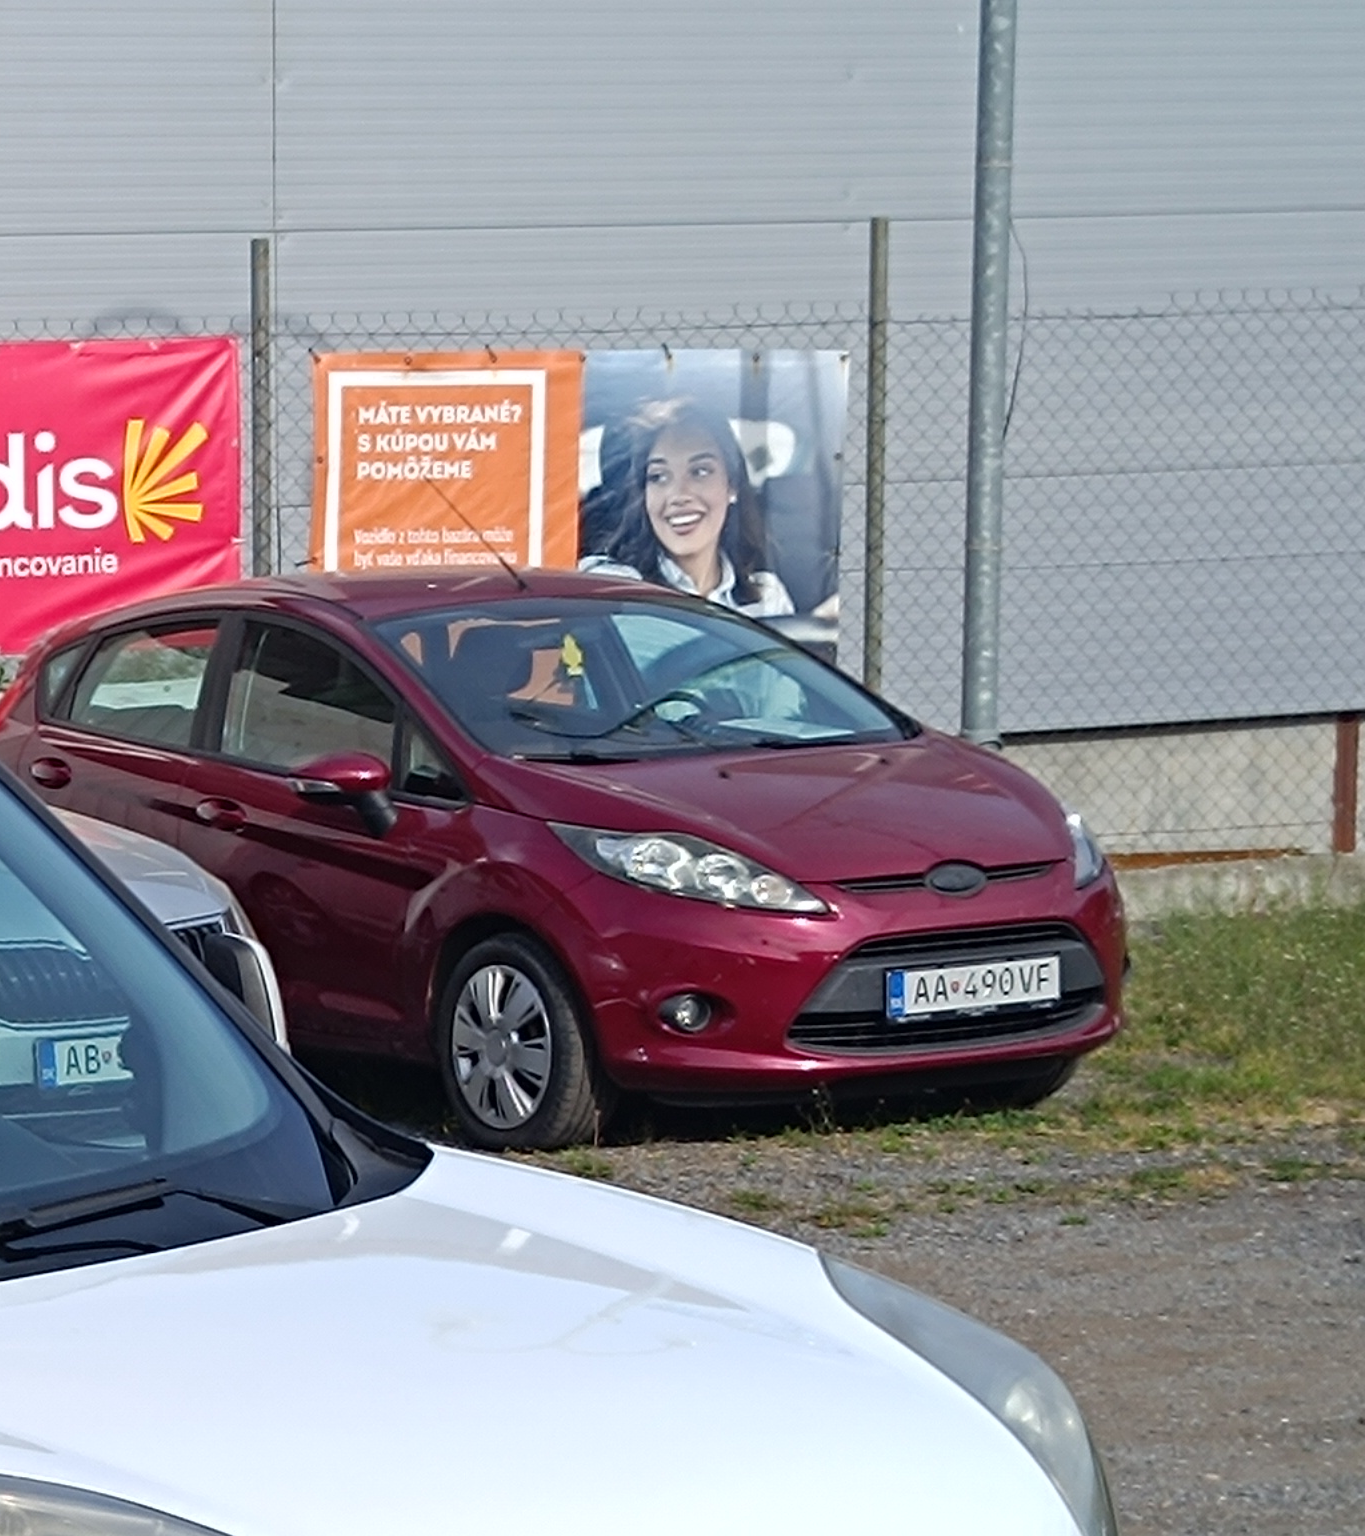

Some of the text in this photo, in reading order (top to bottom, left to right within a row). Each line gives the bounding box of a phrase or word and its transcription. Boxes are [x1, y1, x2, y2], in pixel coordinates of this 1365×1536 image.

[358, 399, 522, 424] MÁTE VYBRANÉ?
[357, 433, 370, 452] S
[452, 427, 497, 450] VÁM
[356, 456, 473, 480] POMÔŽEME
